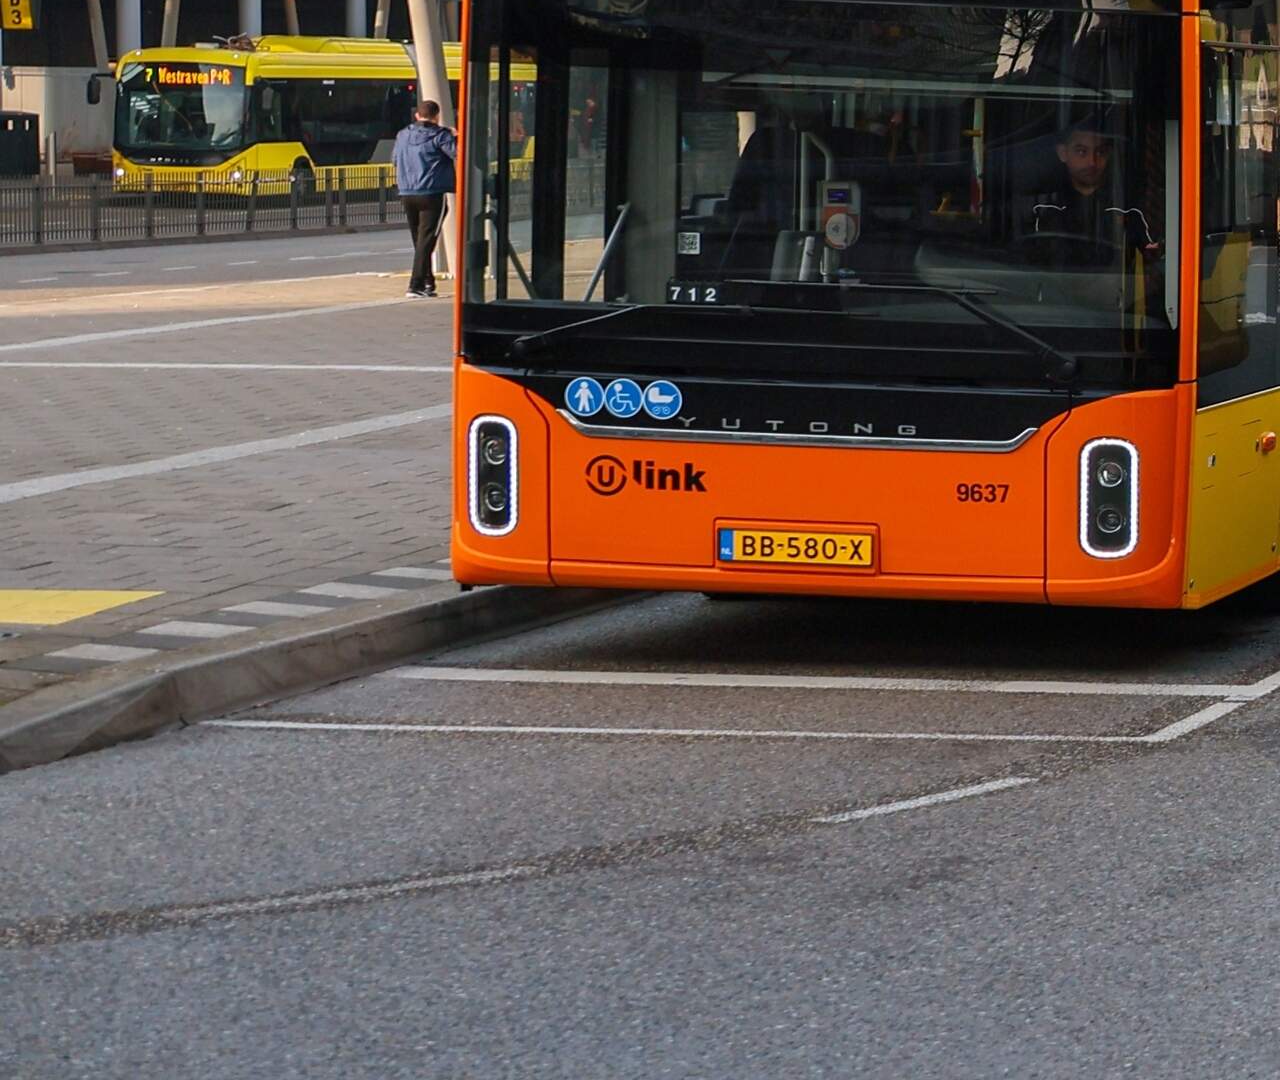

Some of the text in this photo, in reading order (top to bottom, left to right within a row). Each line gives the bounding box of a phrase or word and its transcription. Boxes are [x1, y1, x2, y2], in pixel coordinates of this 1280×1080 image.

[11, 9, 22, 25] 3
[145, 67, 231, 85] 7 Westraven P+R
[670, 286, 717, 302] 712
[678, 417, 917, 436] YUTONG
[955, 483, 1010, 503] 9637
[741, 535, 864, 561] BB-580-X
